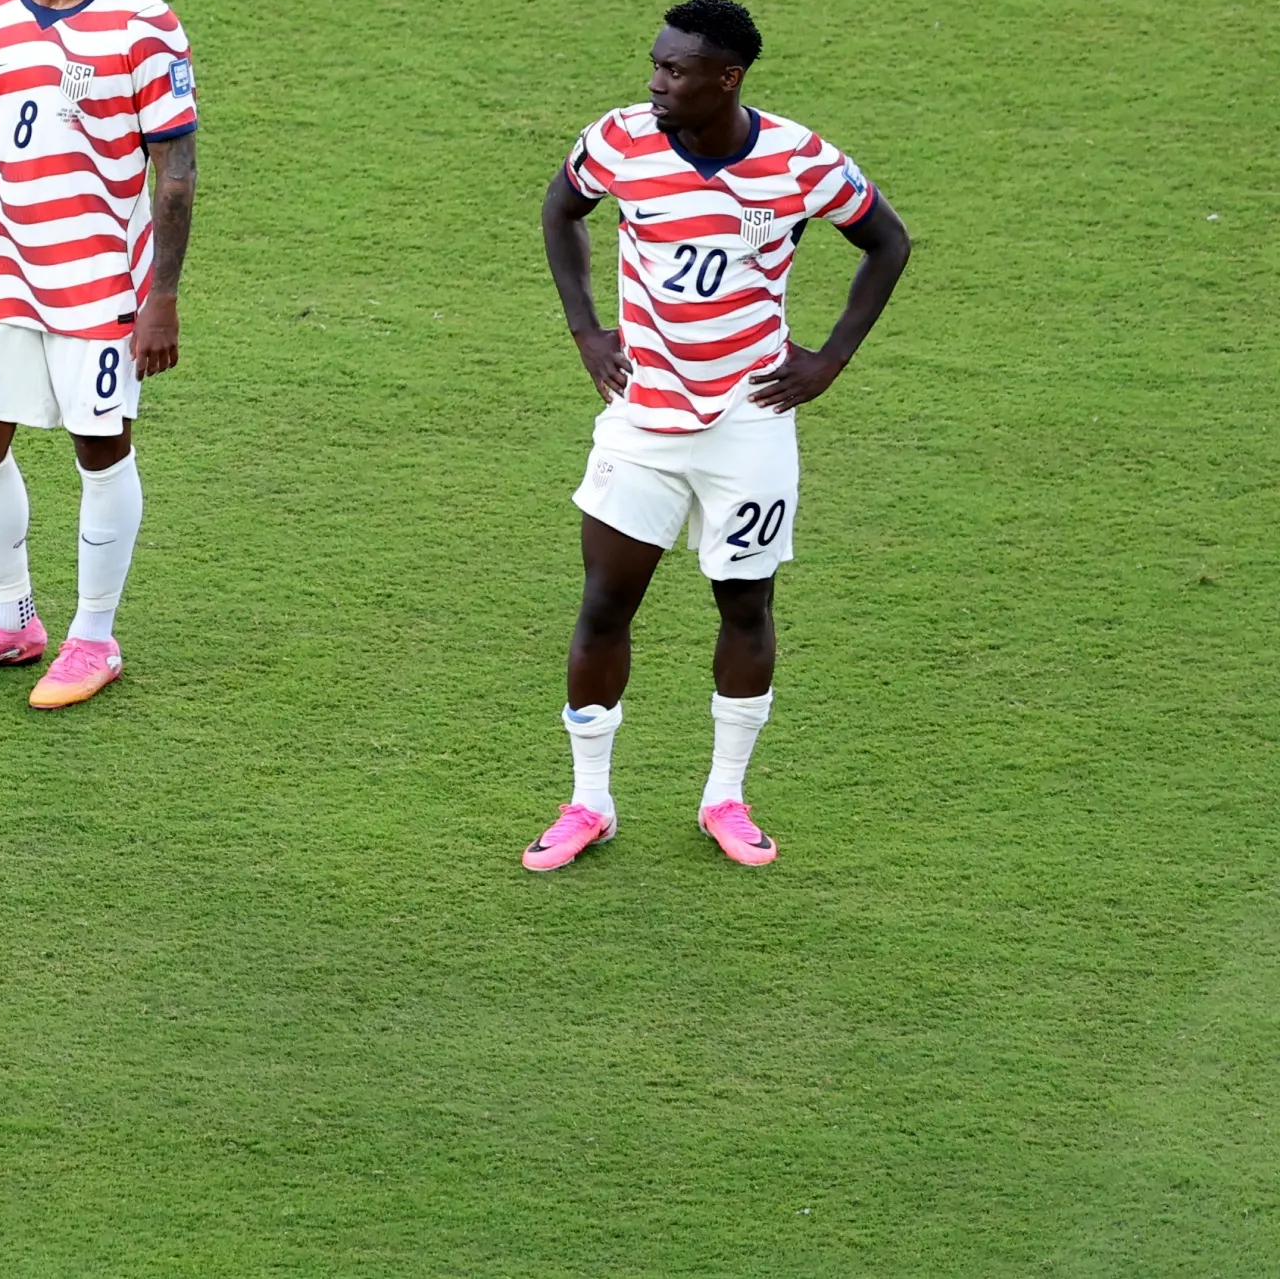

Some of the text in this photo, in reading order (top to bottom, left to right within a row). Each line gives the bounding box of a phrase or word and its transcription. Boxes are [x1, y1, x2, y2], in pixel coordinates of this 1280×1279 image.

[65, 63, 91, 80] USA
[13, 100, 38, 149] 8
[744, 209, 772, 226] USA
[662, 244, 728, 298] 20
[96, 347, 120, 399] 8
[726, 499, 786, 549] 20
